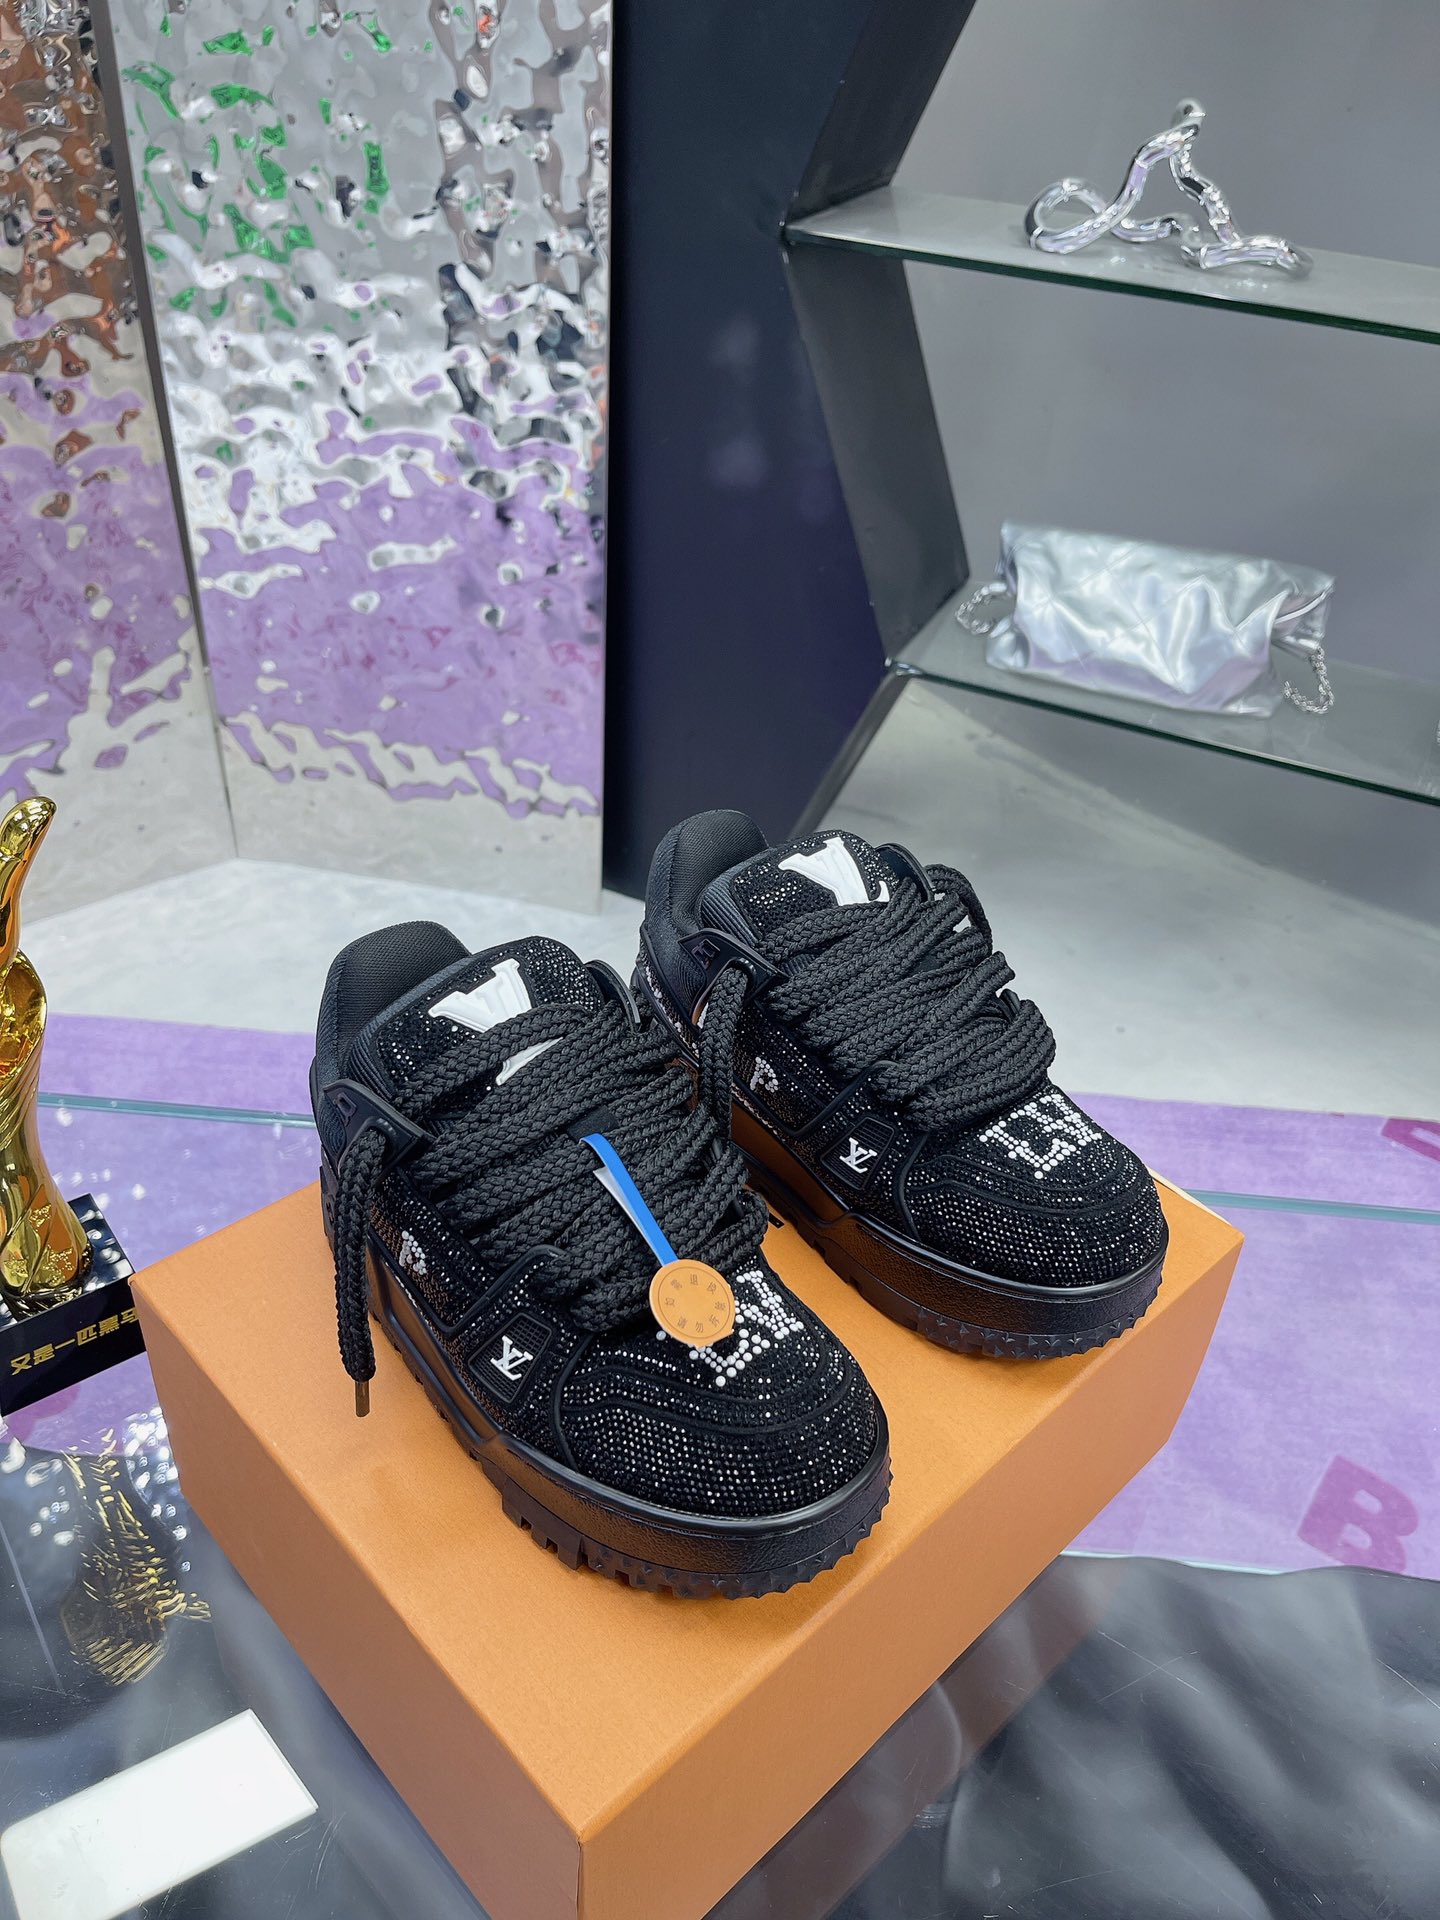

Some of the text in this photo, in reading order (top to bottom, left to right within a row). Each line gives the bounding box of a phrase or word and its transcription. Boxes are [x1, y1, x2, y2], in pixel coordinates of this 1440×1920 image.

[10, 1307, 140, 1376] 又是一匹黑马
